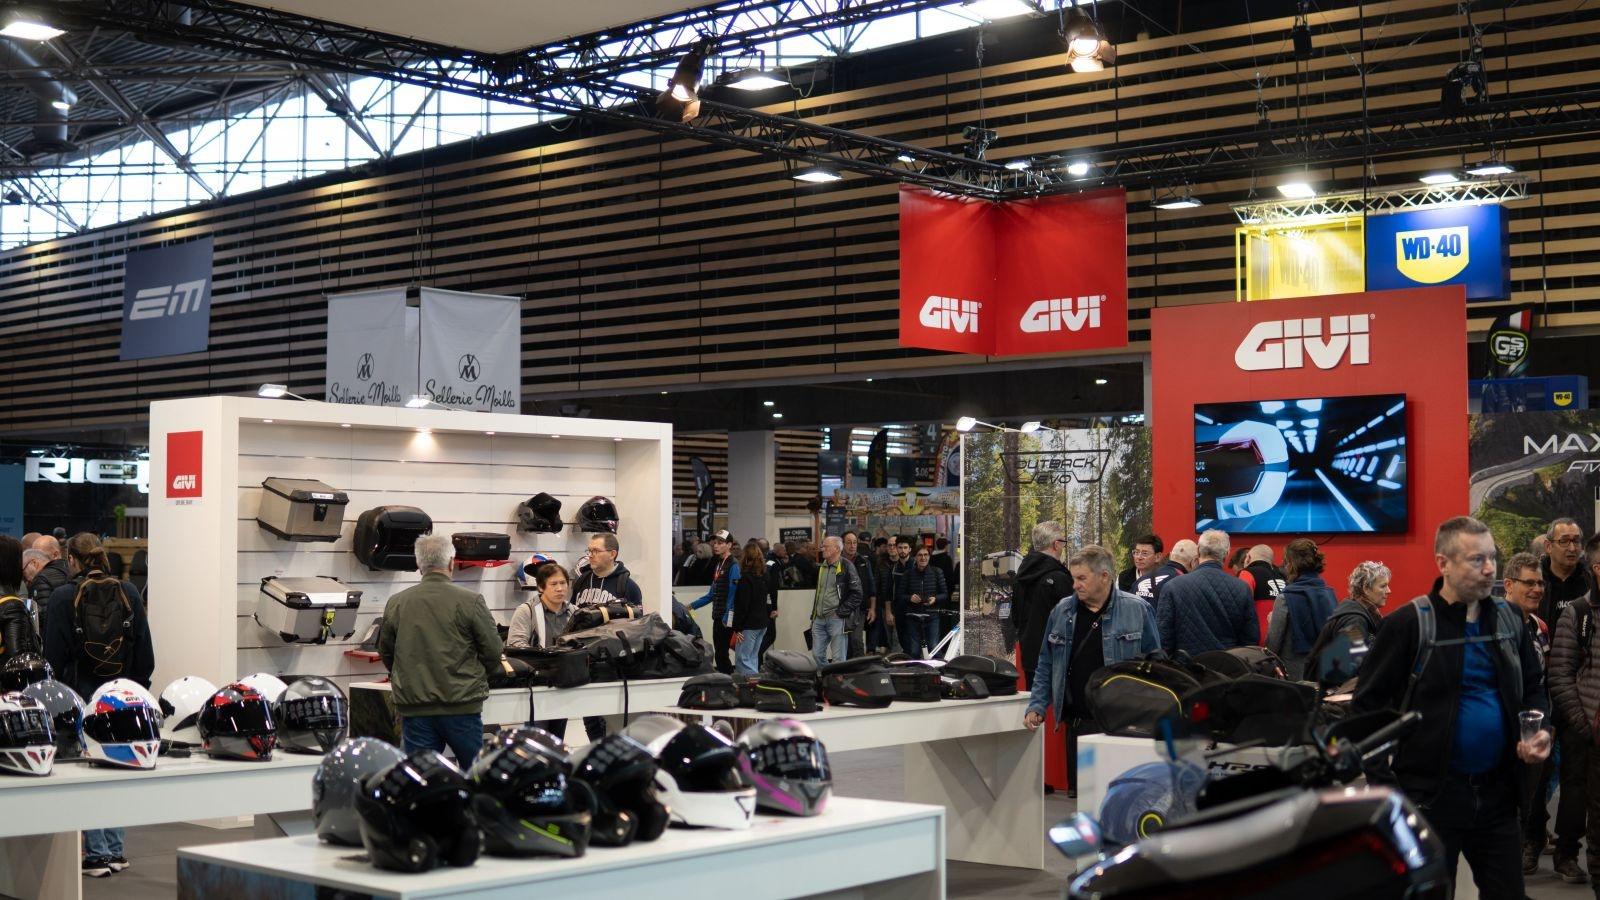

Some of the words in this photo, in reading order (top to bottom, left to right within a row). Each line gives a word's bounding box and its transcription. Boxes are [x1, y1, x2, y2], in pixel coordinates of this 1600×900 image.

[1402, 233, 1462, 261] WD-40
[130, 279, 207, 320] EM
[919, 295, 979, 333] GIVI
[1019, 295, 1101, 333] GIVI
[1235, 314, 1370, 371] GIVI
[425, 379, 474, 406] Sellerie
[1015, 458, 1098, 469] OUTBACK
[1567, 460, 1600, 473] FIV
[173, 475, 196, 489] GIVI
[1036, 474, 1073, 484] EVO
